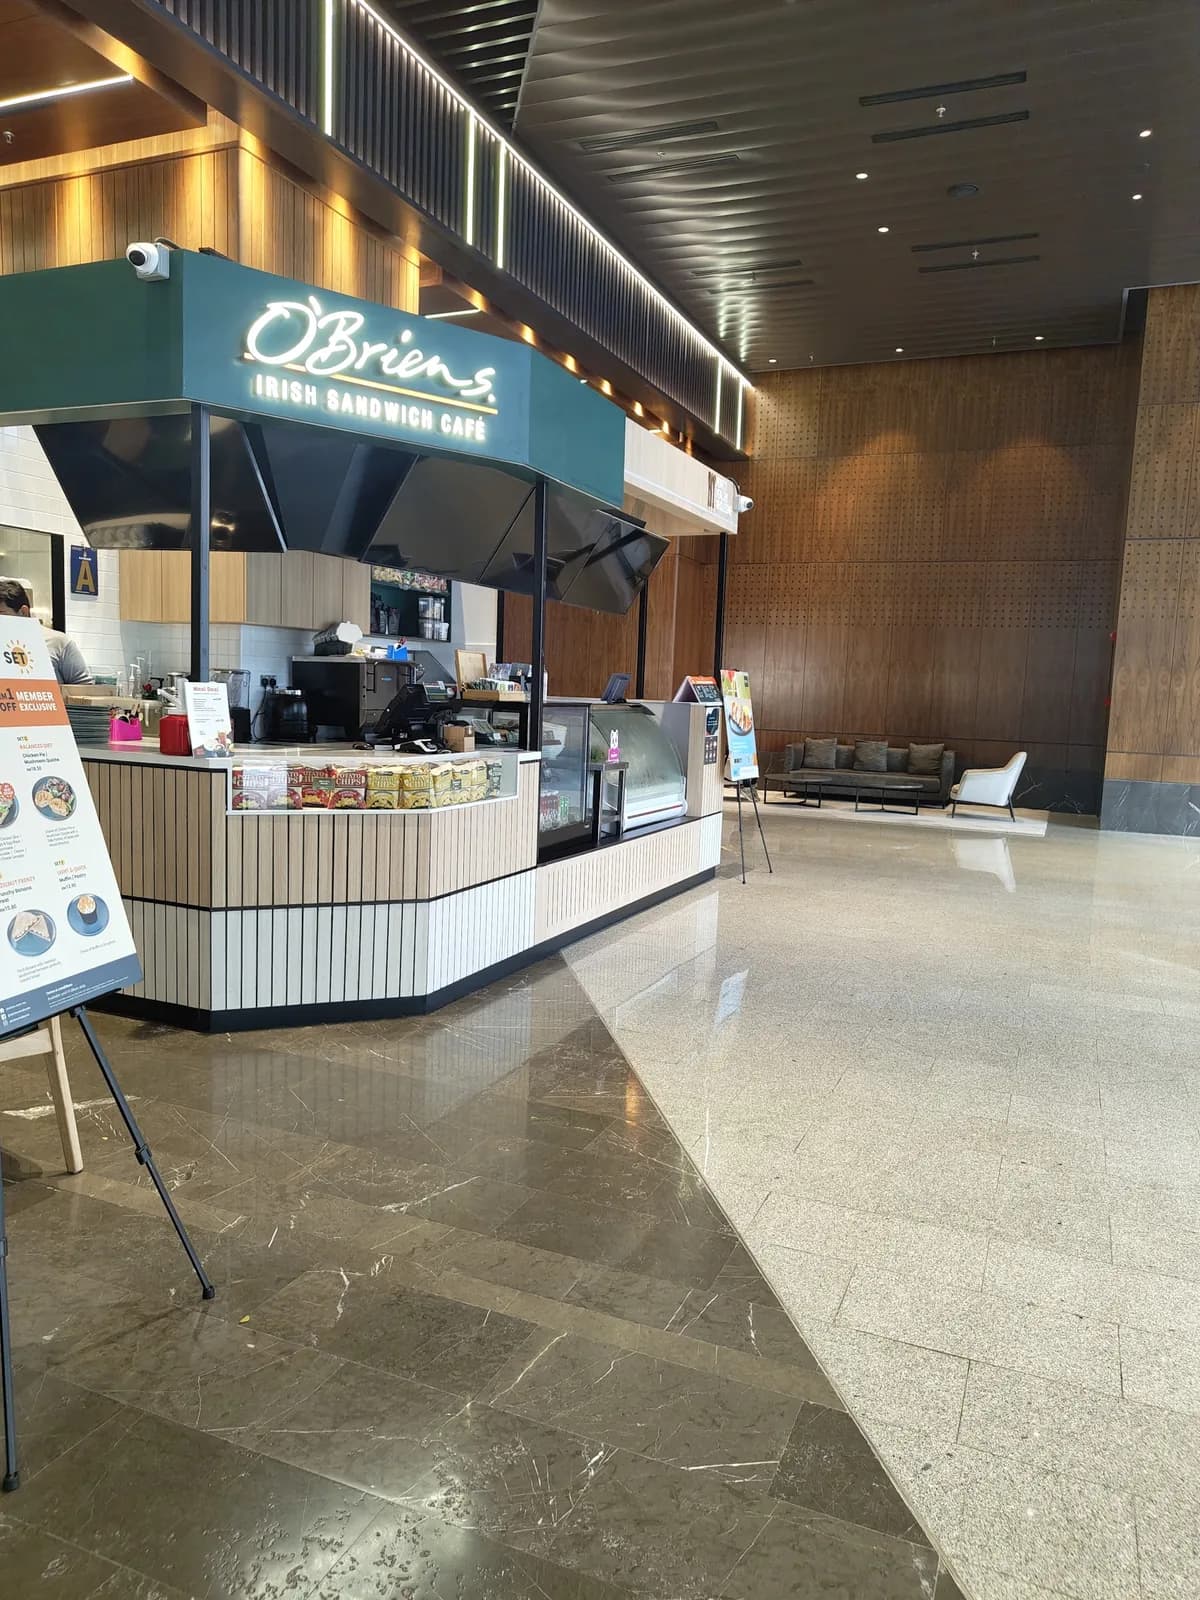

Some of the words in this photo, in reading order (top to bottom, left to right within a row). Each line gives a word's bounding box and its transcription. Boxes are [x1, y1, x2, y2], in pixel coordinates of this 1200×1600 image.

[255, 374, 317, 405] IRISH
[327, 389, 433, 430] SANDWICH
[441, 416, 486, 440] CAFÉ
[76, 560, 96, 592] A
[4, 651, 26, 664] SET
[16, 691, 54, 701] MEMBER
[0, 702, 16, 711] OFF
[19, 702, 57, 711] EXCLUSIVE
